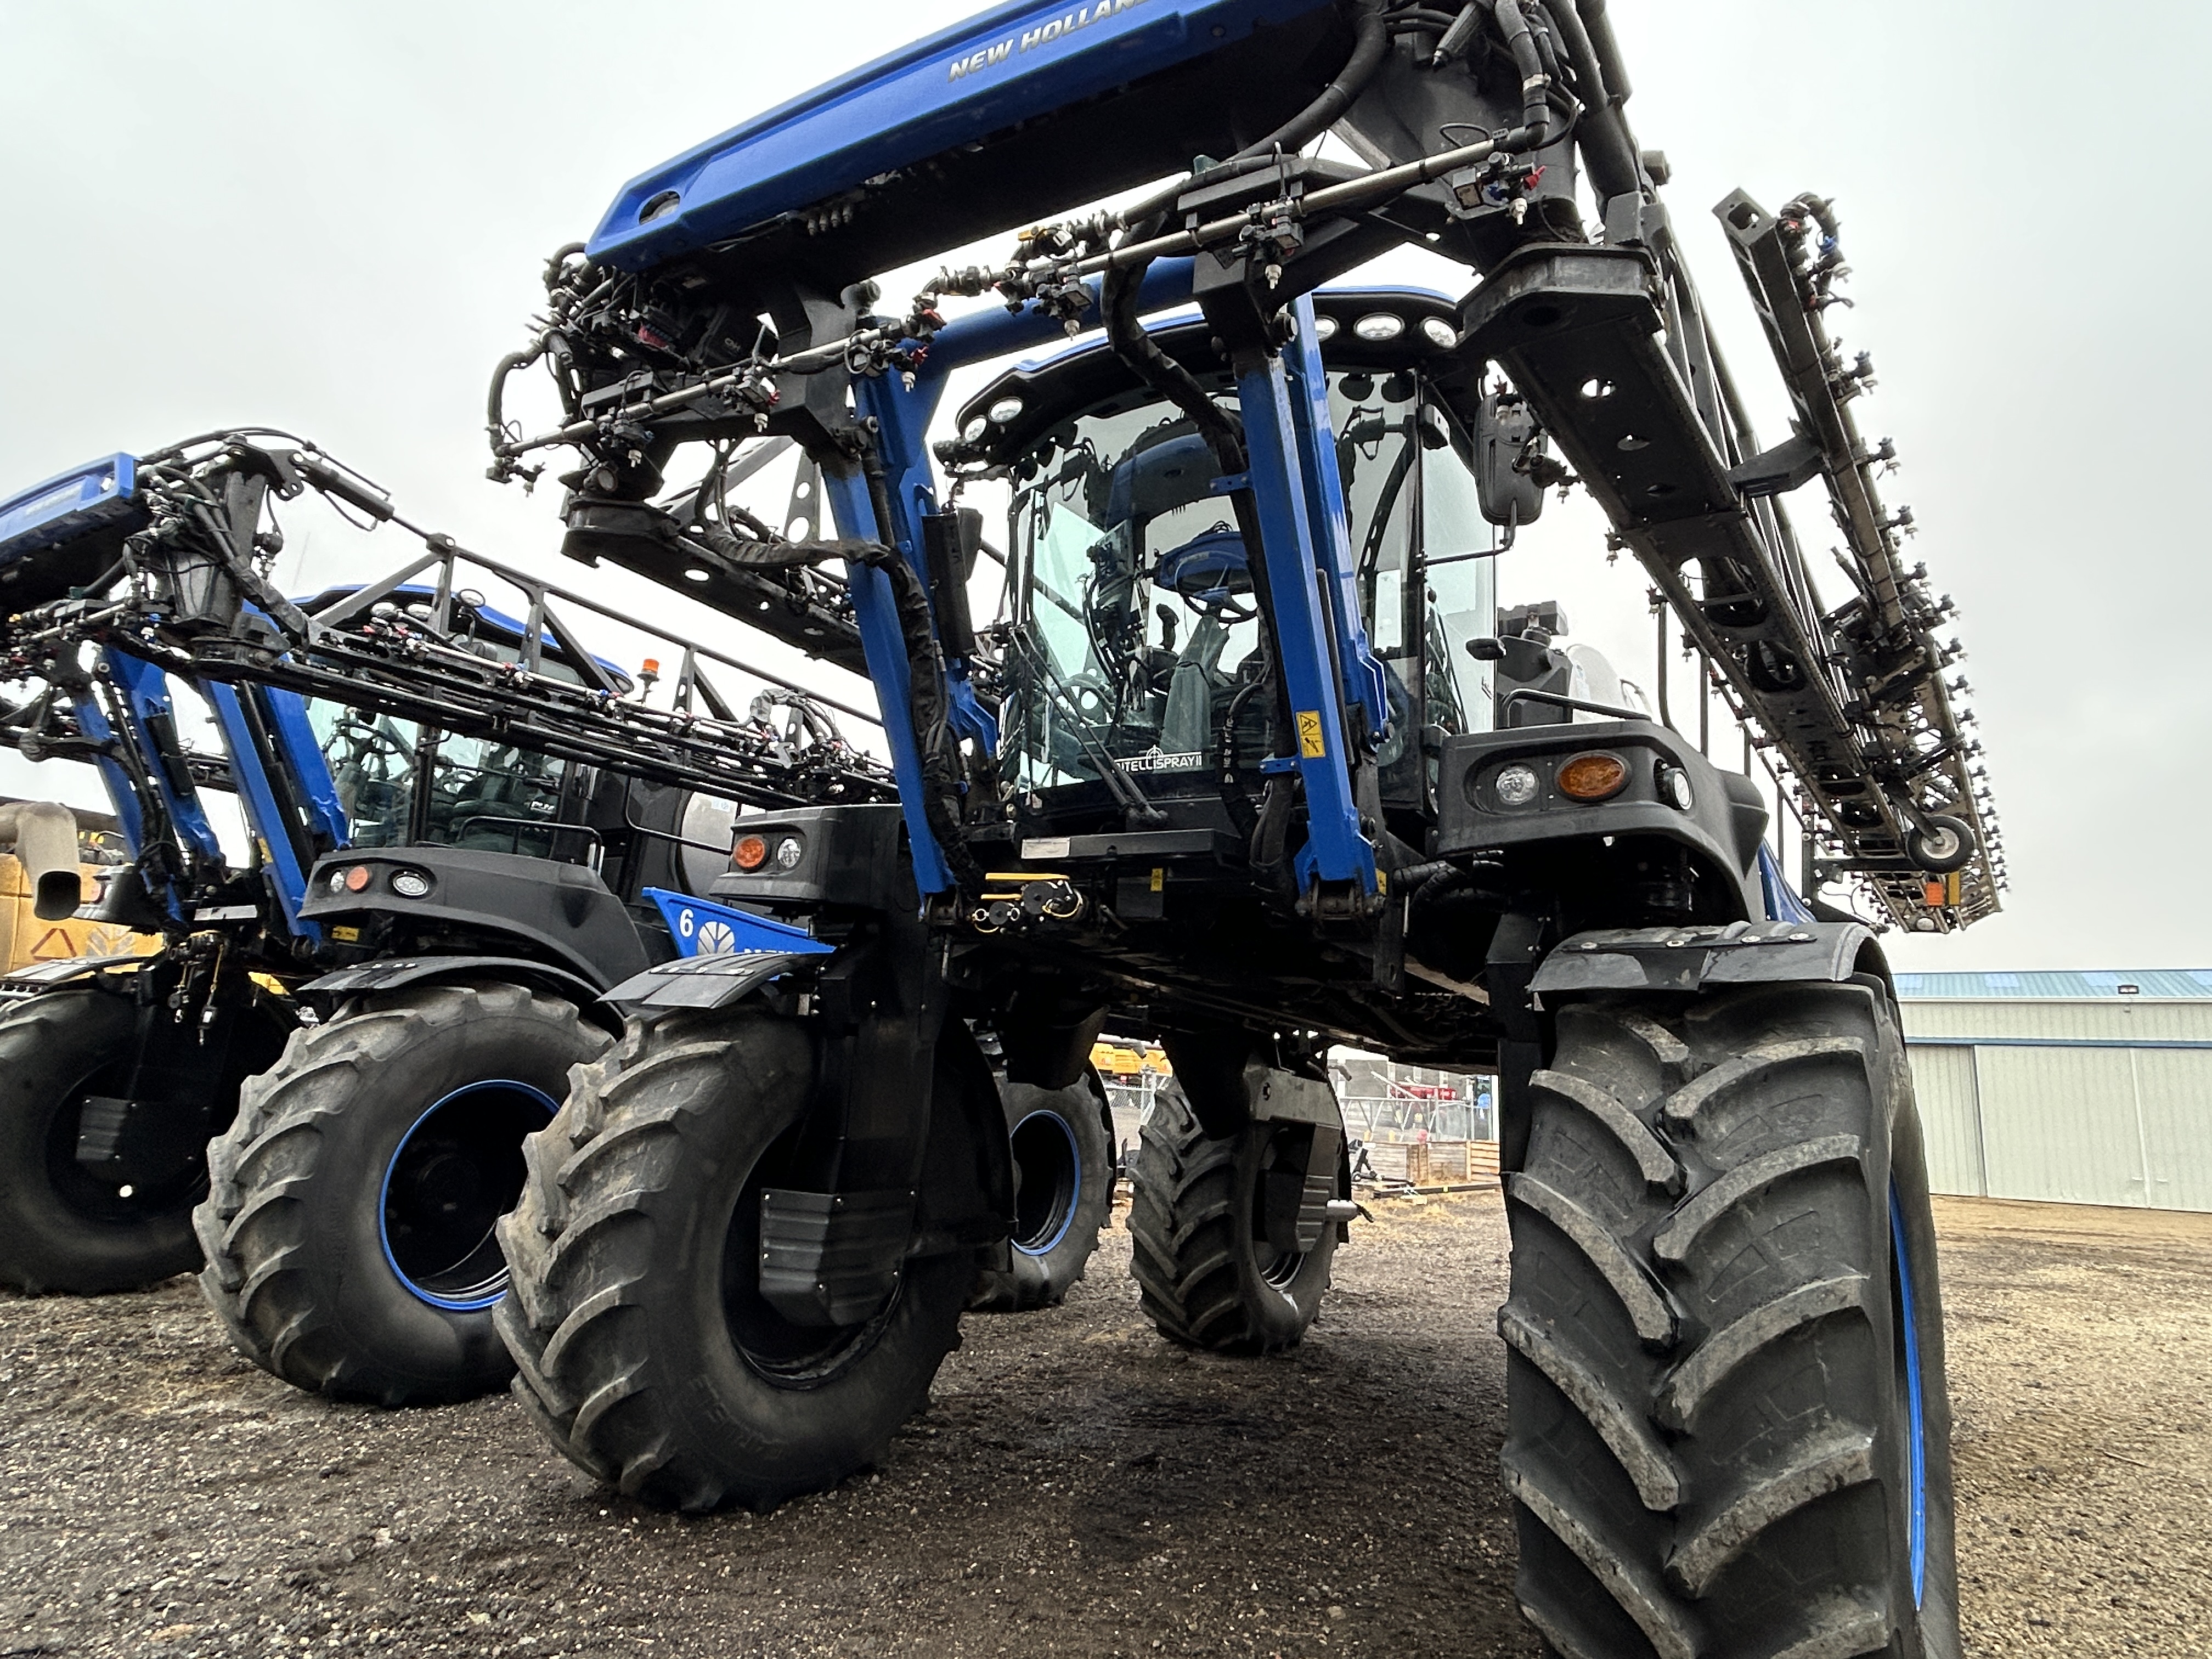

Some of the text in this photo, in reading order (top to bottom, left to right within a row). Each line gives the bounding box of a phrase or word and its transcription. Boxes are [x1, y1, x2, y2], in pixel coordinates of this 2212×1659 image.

[947, 0, 1149, 82] NEW HOLLAN
[680, 909, 693, 937] 6
